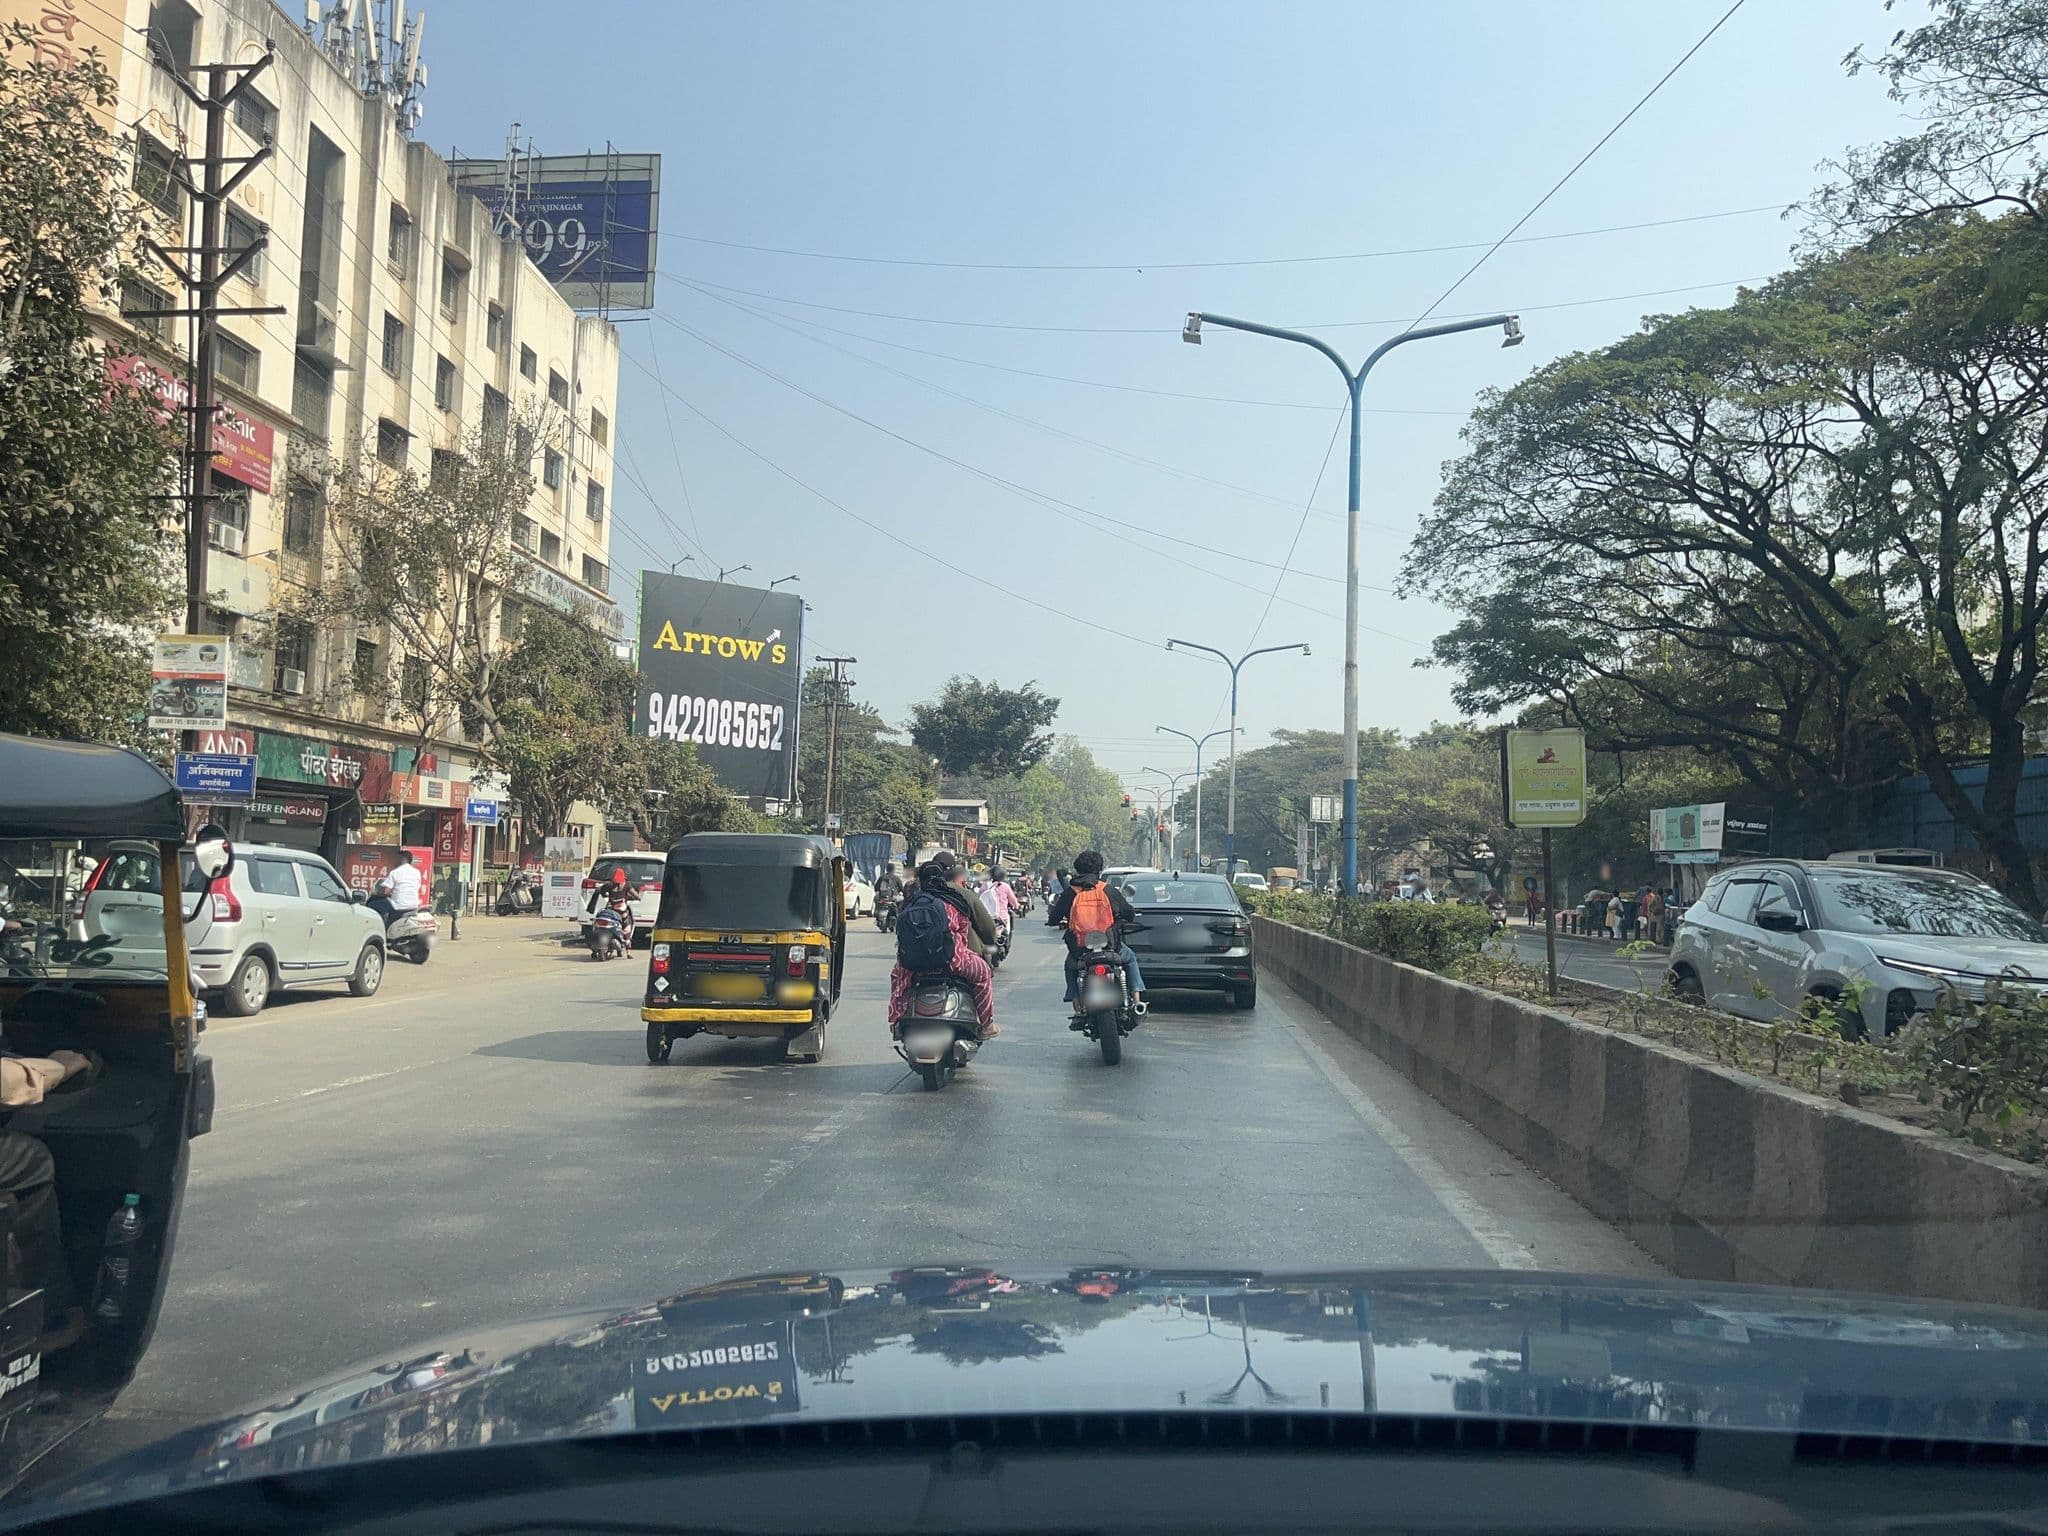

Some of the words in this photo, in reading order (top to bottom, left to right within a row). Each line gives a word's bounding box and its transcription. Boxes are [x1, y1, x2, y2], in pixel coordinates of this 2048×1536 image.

[648, 692, 784, 751] 9422085652
[203, 732, 247, 755] AND
[301, 746, 328, 777] पीटर
[274, 804, 322, 817] ENGLAND
[443, 821, 453, 833] 4
[442, 839, 452, 851] 6
[351, 864, 377, 876] BUY
[379, 866, 388, 877] 4
[350, 876, 378, 888] GET
[719, 934, 742, 944] TVS
